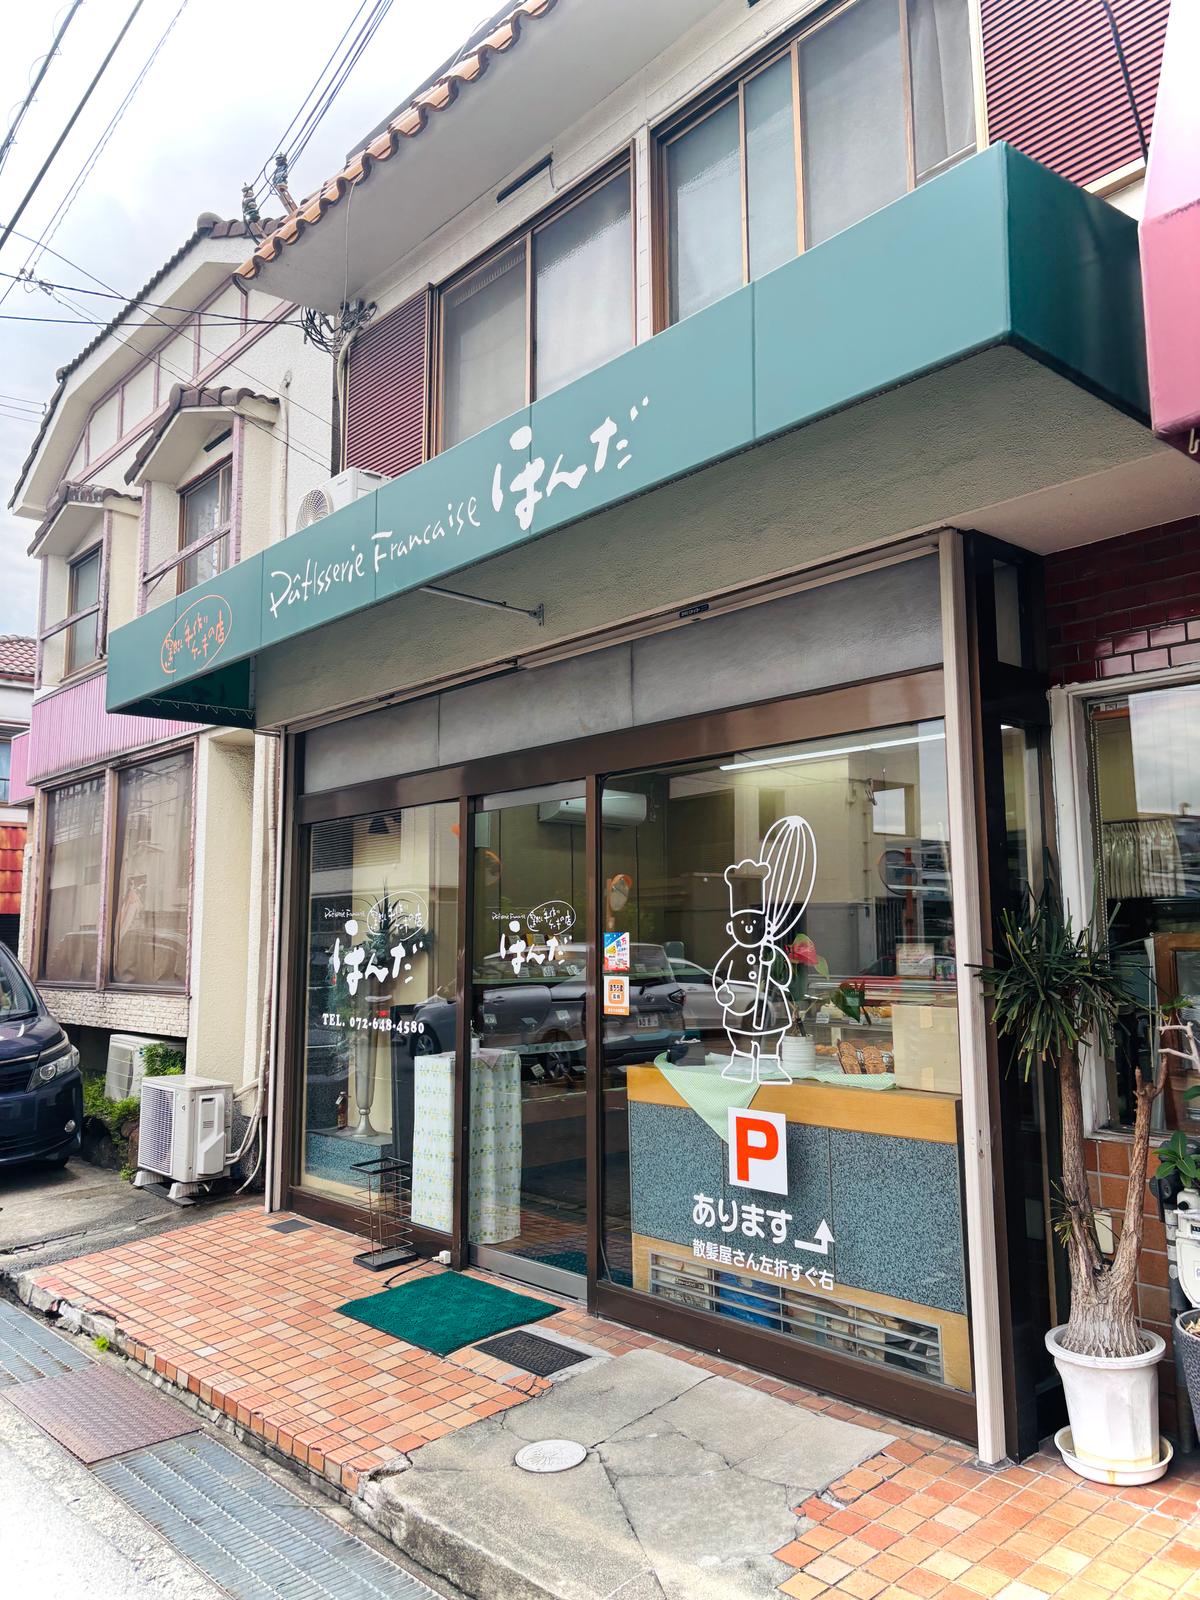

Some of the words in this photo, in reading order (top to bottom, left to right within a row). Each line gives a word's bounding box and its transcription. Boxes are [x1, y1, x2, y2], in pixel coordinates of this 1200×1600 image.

[371, 496, 480, 573] Francaise
[322, 1013, 346, 1027] TEL.
[735, 1115, 779, 1182] P
[692, 1192, 793, 1244] あります
[692, 1238, 835, 1291] 散髪屋さん左折すぐ右
